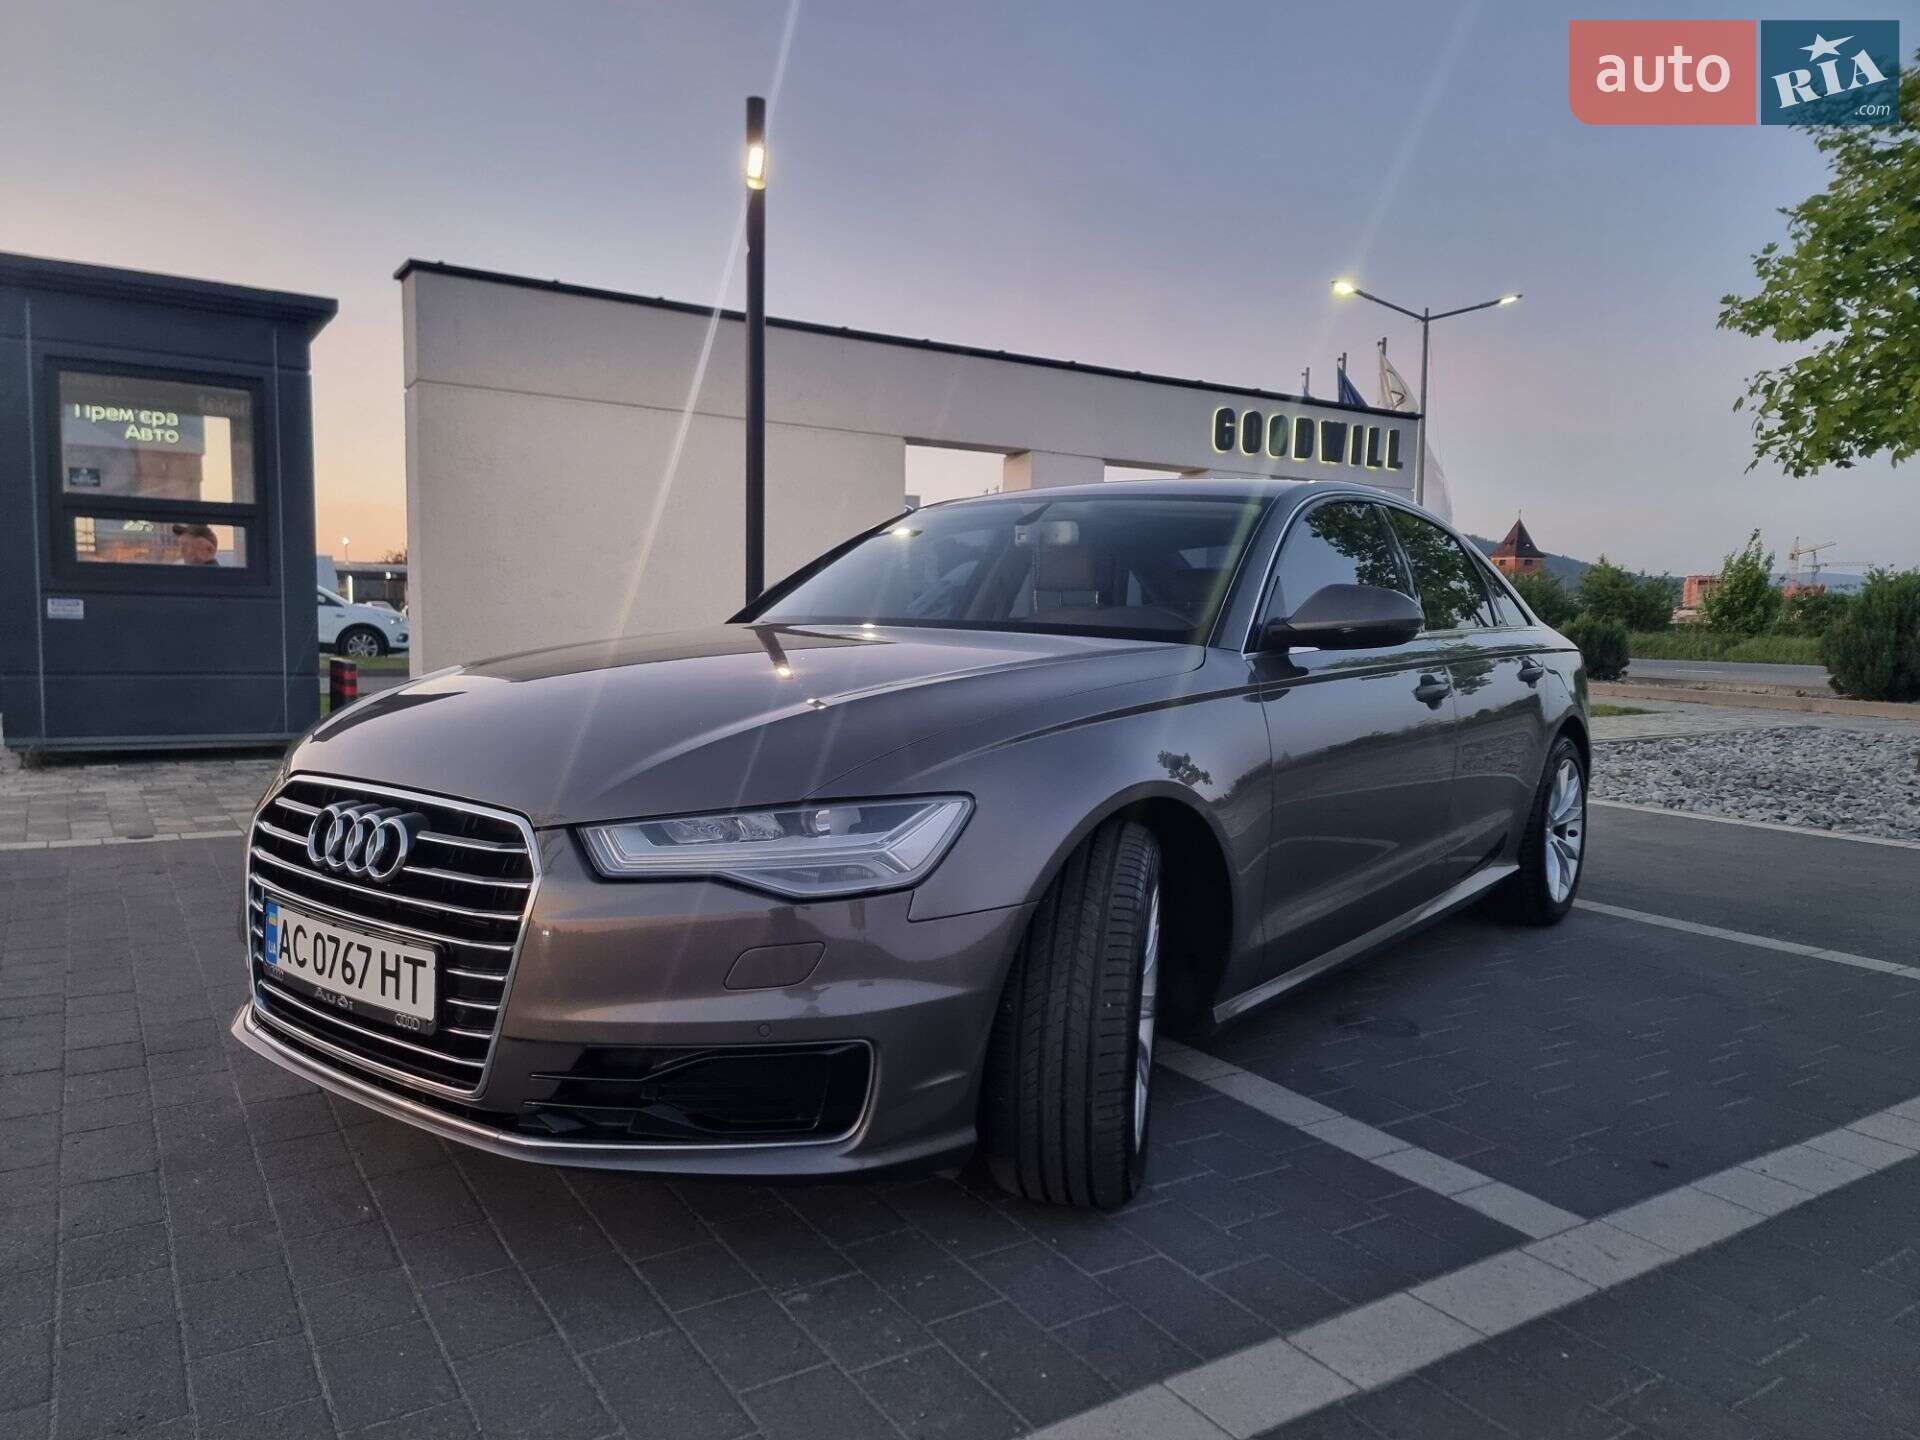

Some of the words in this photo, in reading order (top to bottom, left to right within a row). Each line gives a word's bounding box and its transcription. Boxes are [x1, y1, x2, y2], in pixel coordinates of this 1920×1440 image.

[125, 423, 179, 443] Авто
[1213, 406, 1403, 470] GOODWILL
[279, 919, 308, 969] AC
[313, 932, 372, 990] 0767
[380, 951, 427, 1004] HT
